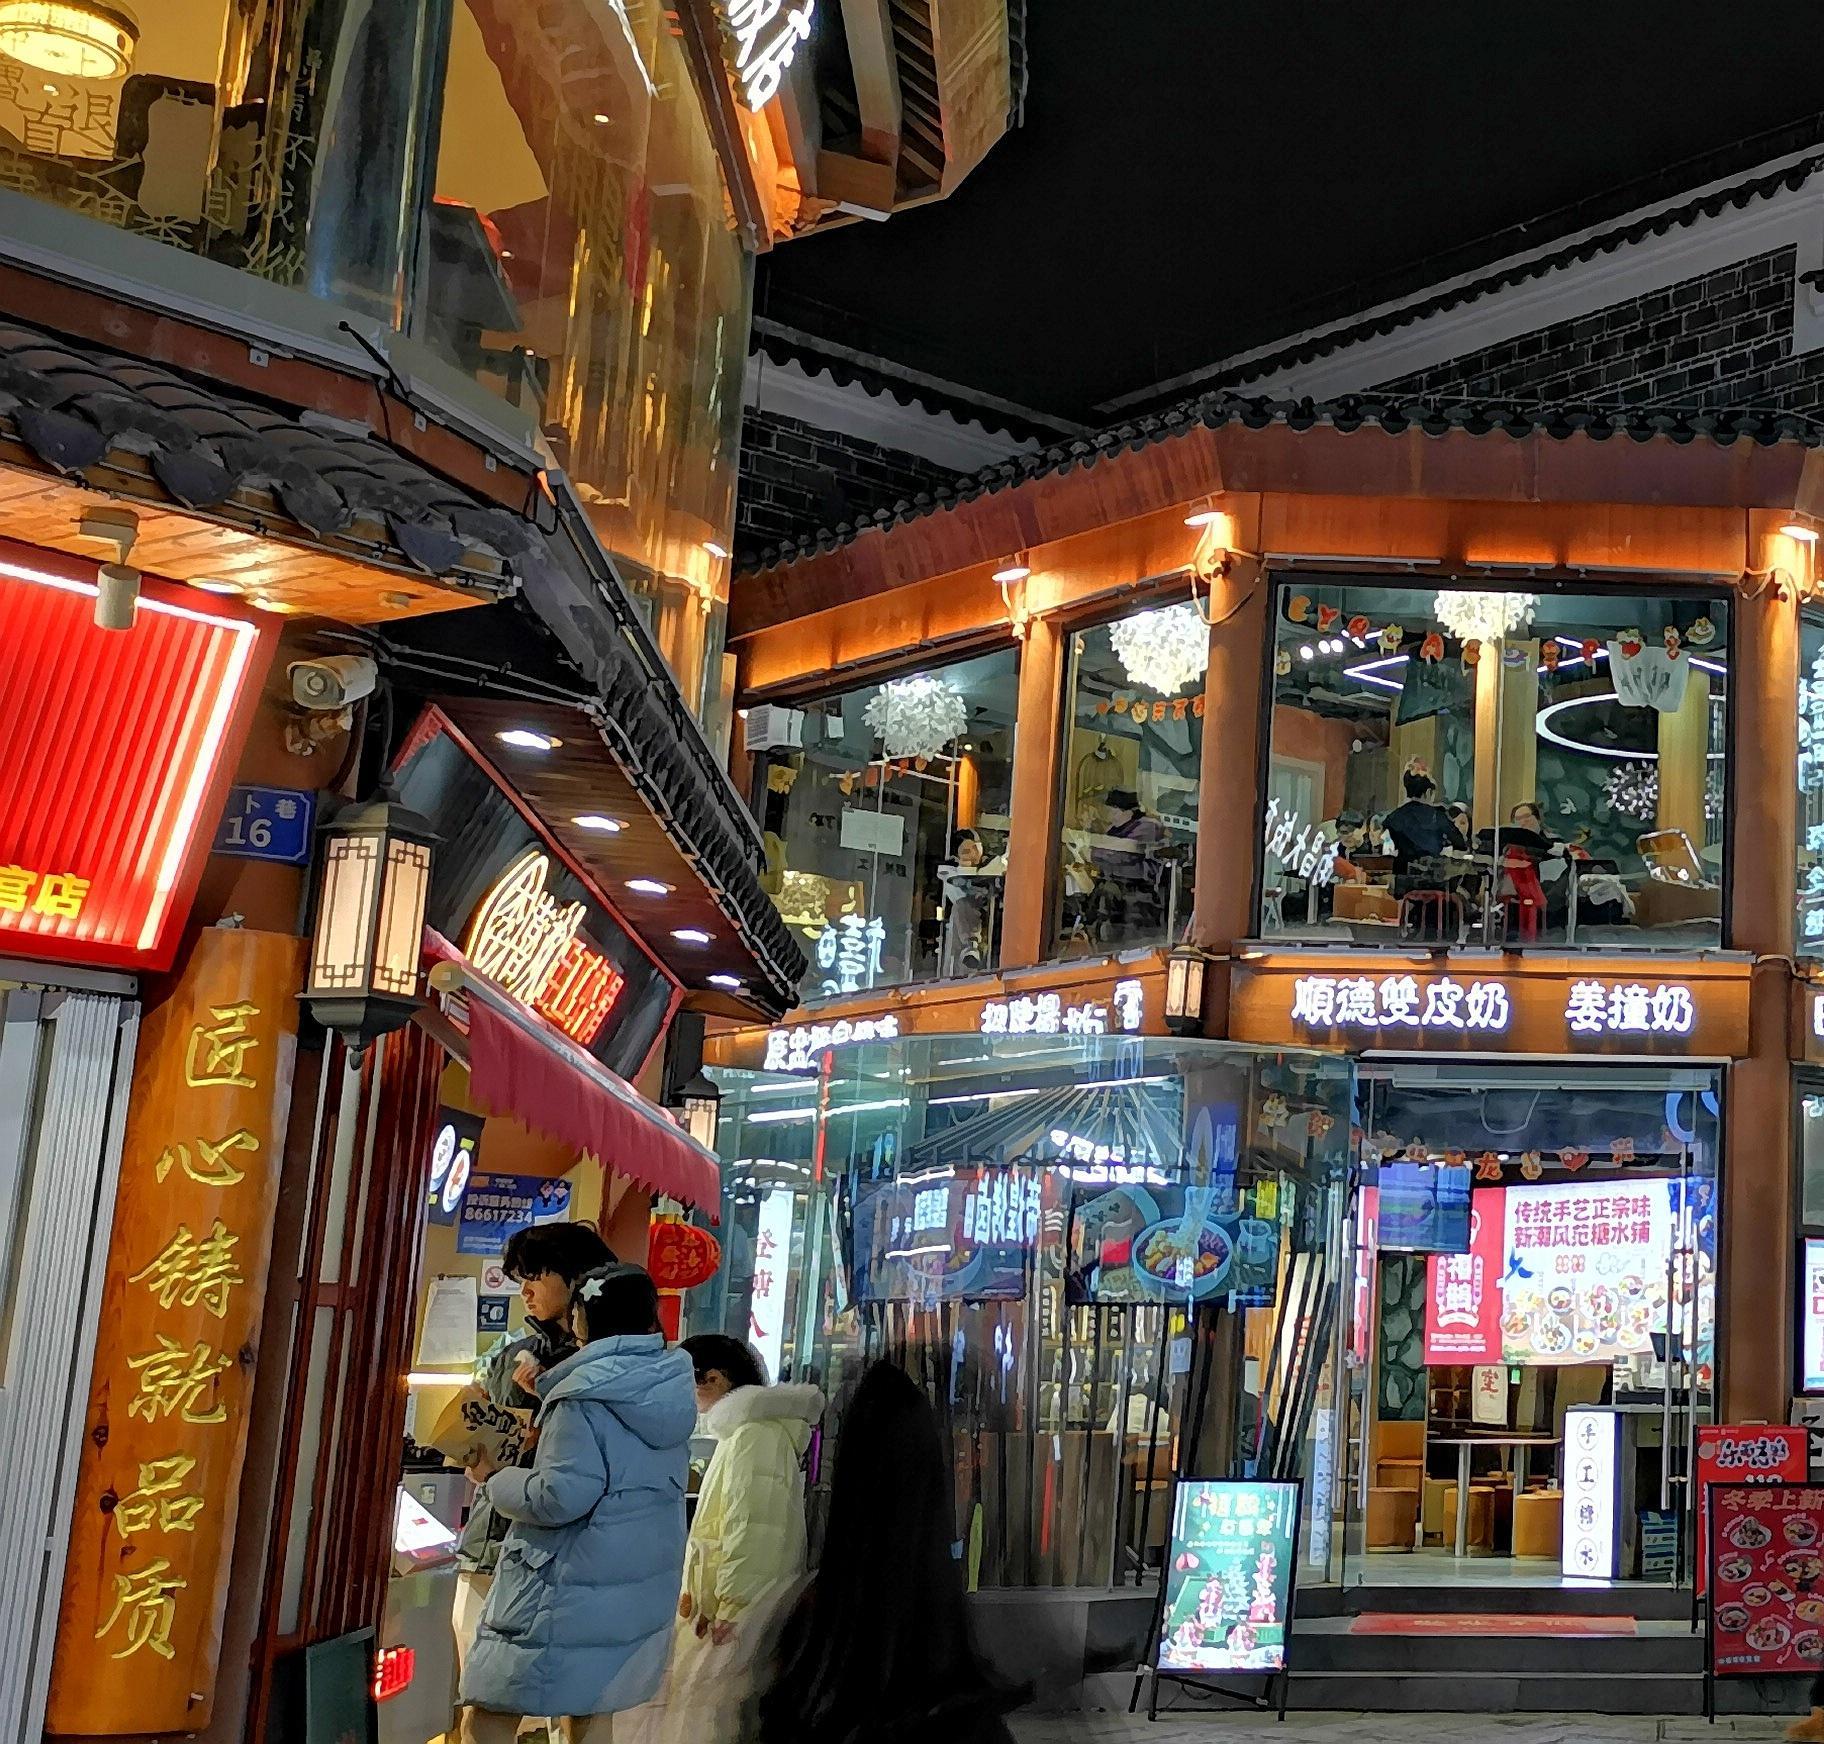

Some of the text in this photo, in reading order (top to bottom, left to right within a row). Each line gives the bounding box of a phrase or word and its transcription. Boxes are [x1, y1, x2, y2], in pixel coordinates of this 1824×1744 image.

[224, 816, 272, 848] 16
[1292, 976, 1510, 1031] 順德雙皮奶
[1564, 980, 1695, 1033] 姜撞奶
[464, 1206, 533, 1224] 86617234
[1514, 1195, 1652, 1226] 传统手艺正宗味
[1514, 1220, 1651, 1249] 新潮风范糖水铺
[95, 1002, 262, 1661] 匠心铸就品质
